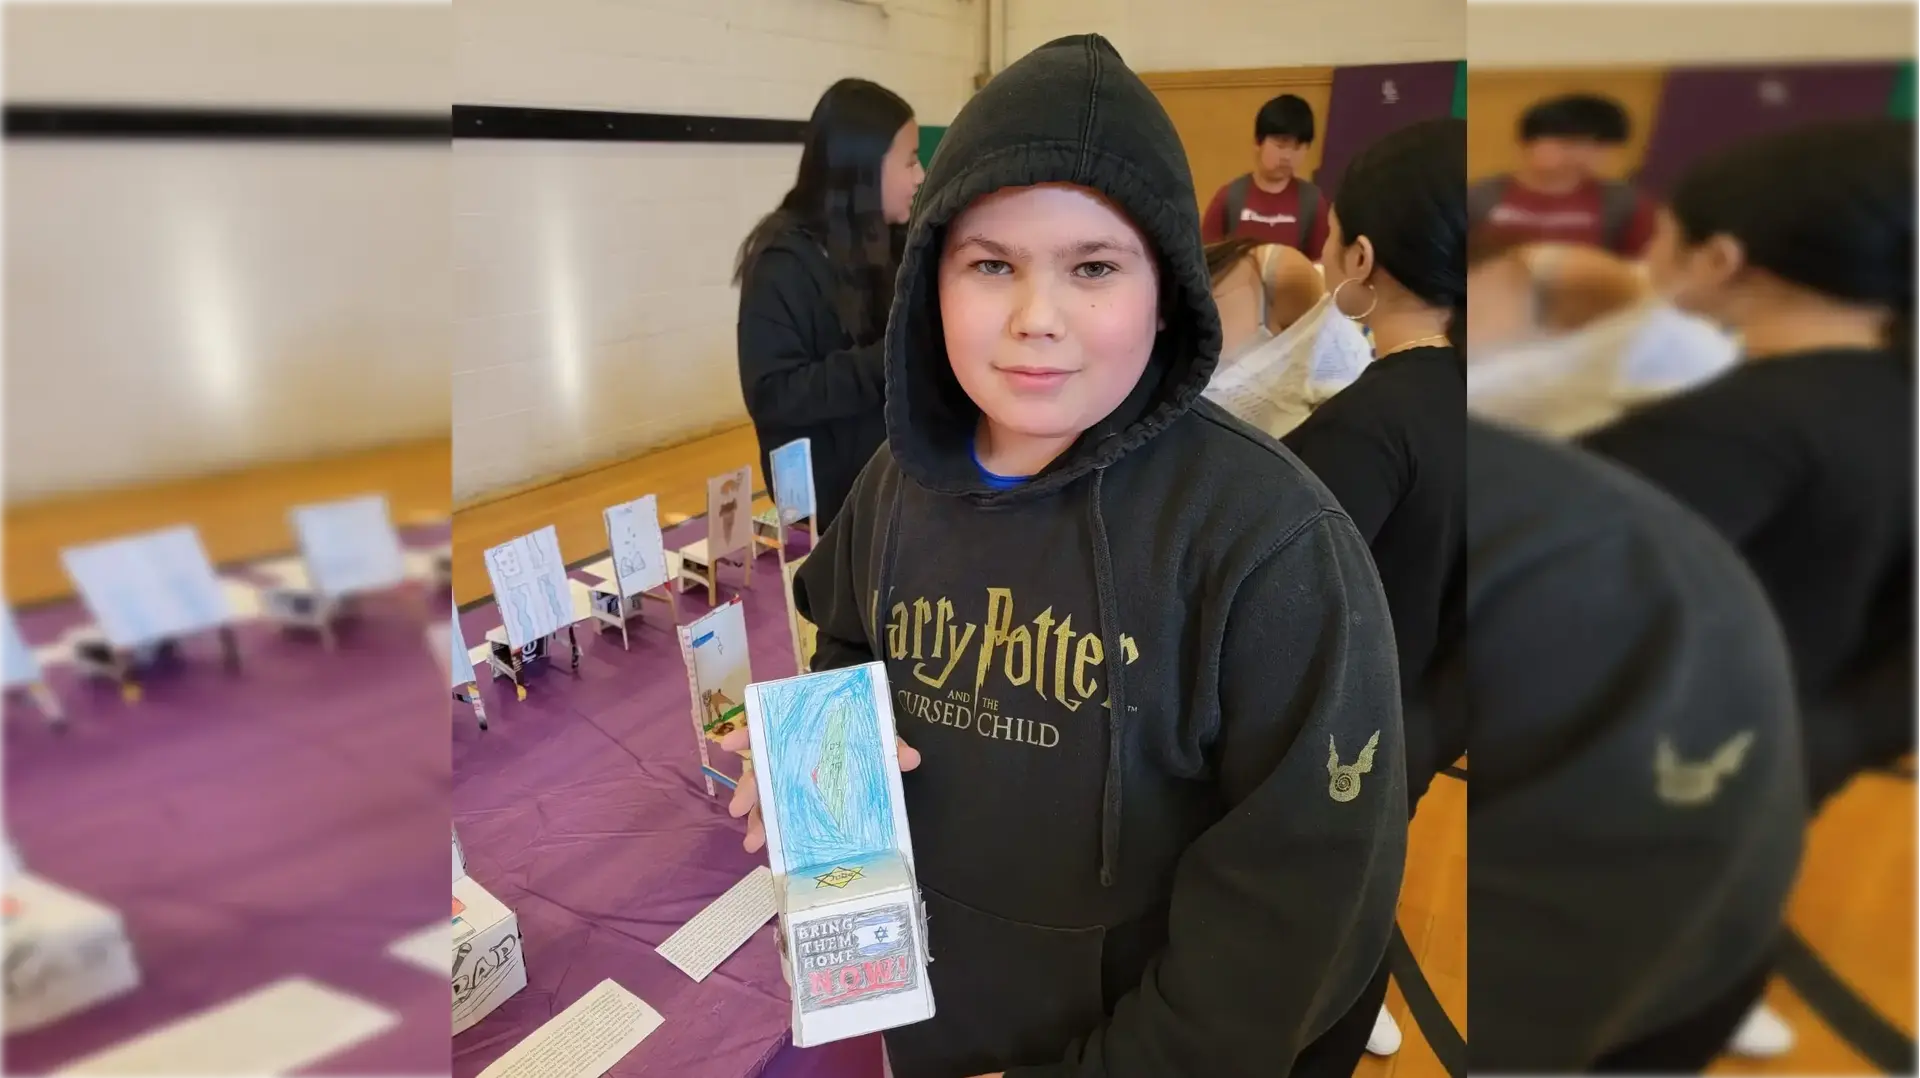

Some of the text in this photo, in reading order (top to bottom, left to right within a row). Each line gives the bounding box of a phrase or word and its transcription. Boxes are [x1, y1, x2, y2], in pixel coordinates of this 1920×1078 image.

[946, 689, 999, 711] AND THE
[897, 690, 1060, 748] CURSED CHILD
[799, 918, 854, 940] BRING
[801, 935, 852, 954] THEM
[804, 953, 855, 969] HOME
[808, 955, 908, 996] NOW!
